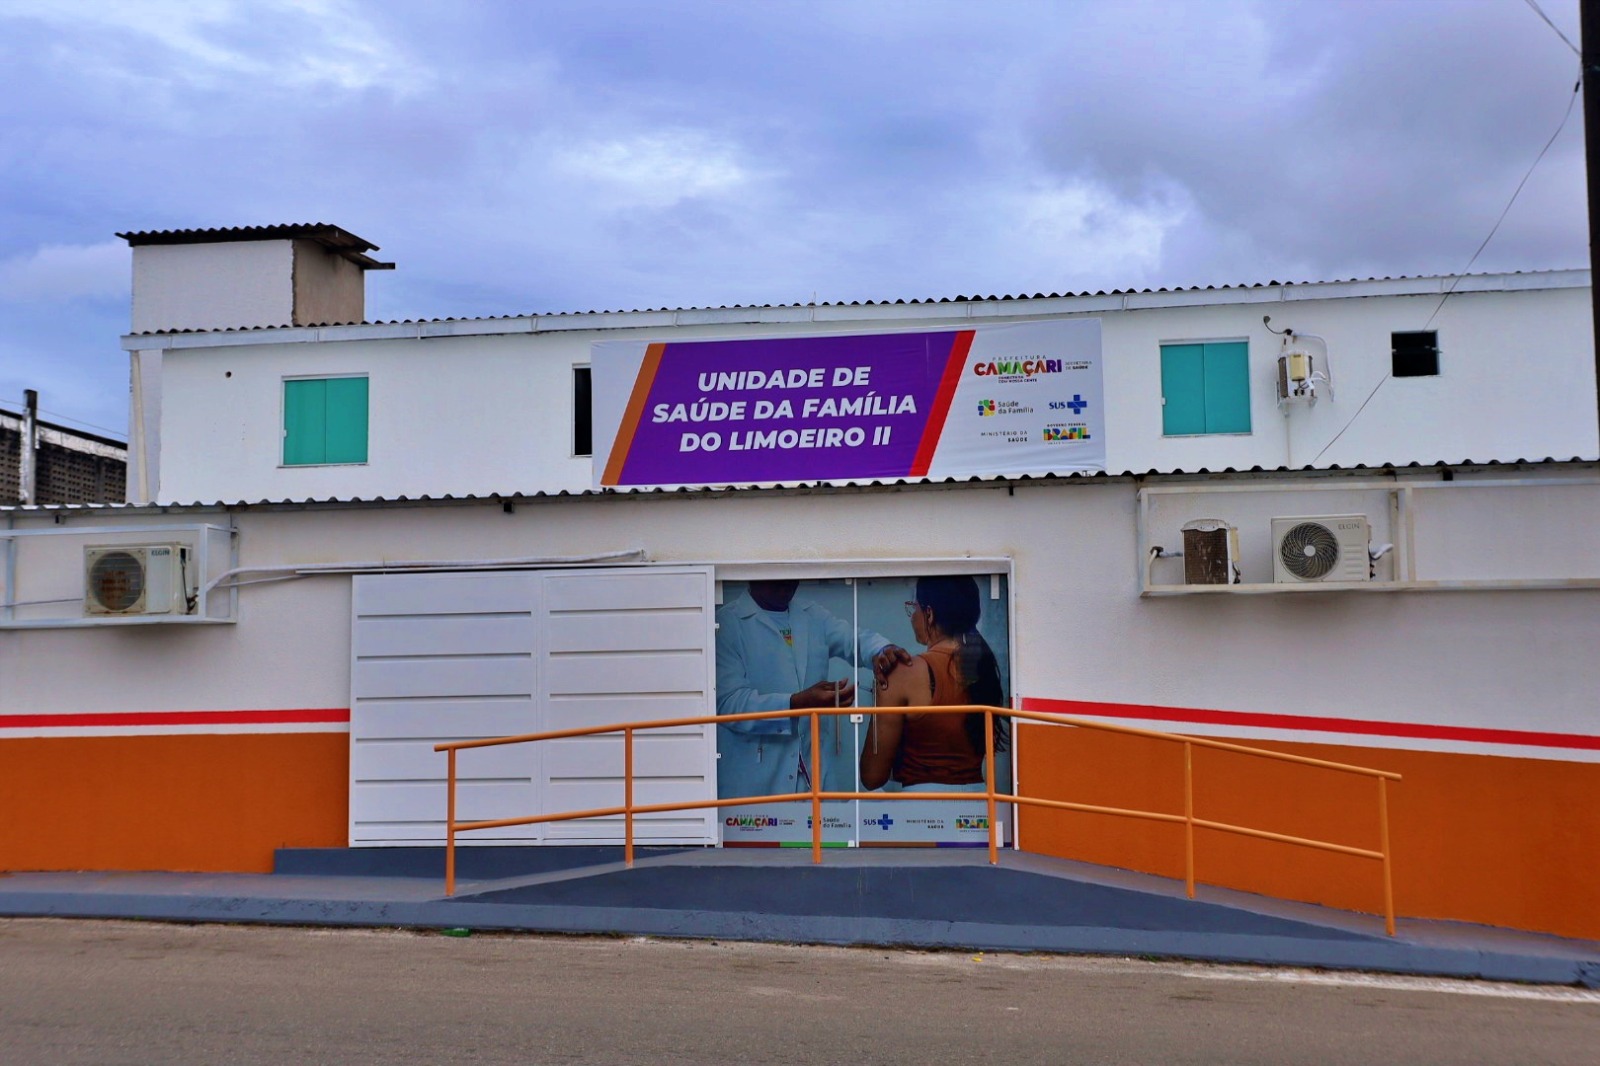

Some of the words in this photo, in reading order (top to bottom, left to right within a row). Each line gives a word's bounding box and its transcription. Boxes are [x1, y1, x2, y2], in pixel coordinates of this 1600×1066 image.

[974, 359, 1062, 377] CAMAÇARI
[698, 368, 826, 392] UNIDADE
[832, 366, 871, 387] DE
[652, 397, 747, 423] SAÚDE
[753, 400, 794, 420] DA
[802, 391, 917, 418] FAMÍLIA
[1008, 406, 1034, 414] Família
[1049, 401, 1066, 410] SUS
[679, 432, 722, 452] DO
[728, 427, 865, 451] LIMOEIRO
[872, 426, 892, 446] II
[1043, 427, 1091, 441] BRASIL
[726, 817, 778, 828] CAMAÇARI
[956, 818, 989, 829] BRASI
